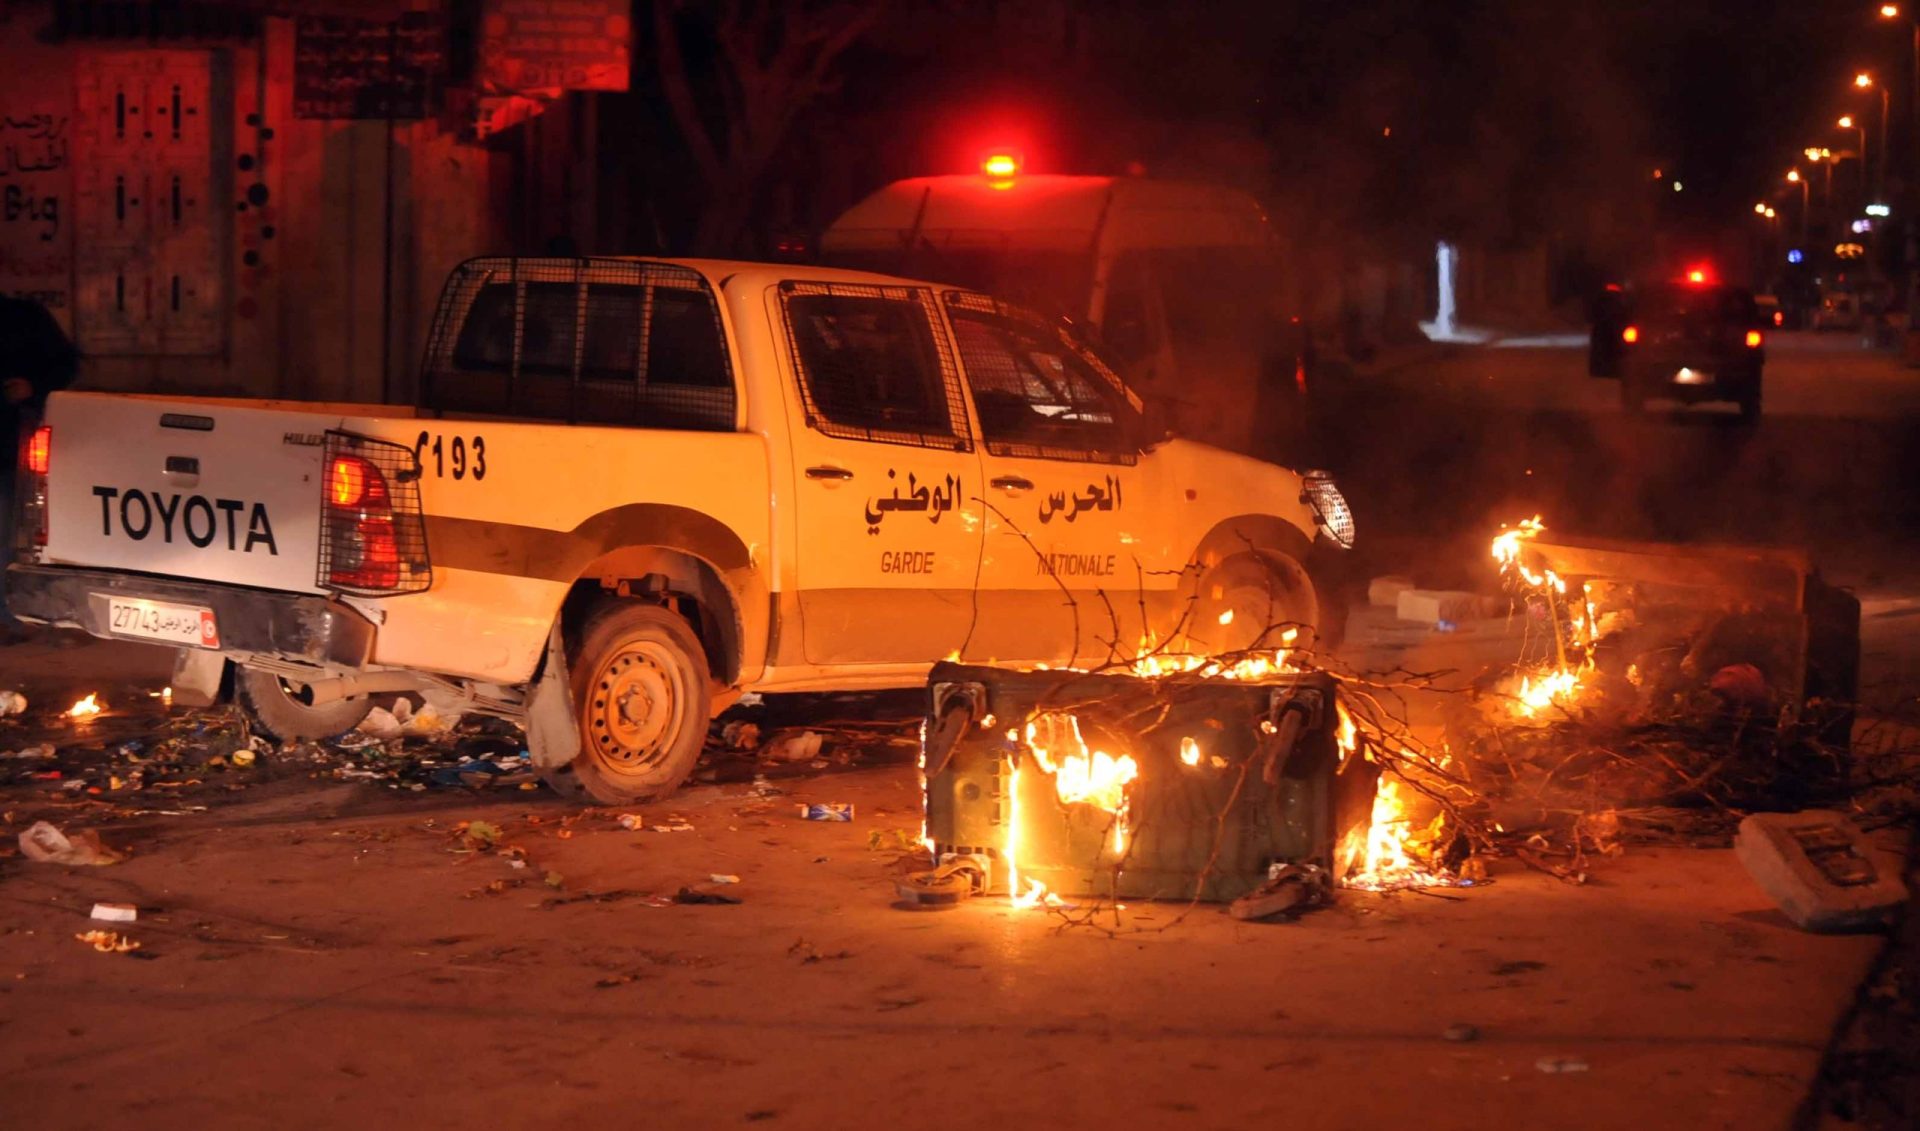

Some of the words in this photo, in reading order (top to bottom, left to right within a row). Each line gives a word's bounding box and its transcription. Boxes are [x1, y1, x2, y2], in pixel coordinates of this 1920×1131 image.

[5, 185, 58, 240] Big
[92, 486, 278, 556] TOYOTA
[865, 468, 961, 536] الوطني
[1038, 474, 1121, 524] الحرس
[881, 551, 935, 574] GARDE
[1036, 553, 1116, 576] NATIONALE
[114, 606, 159, 631] 27743
